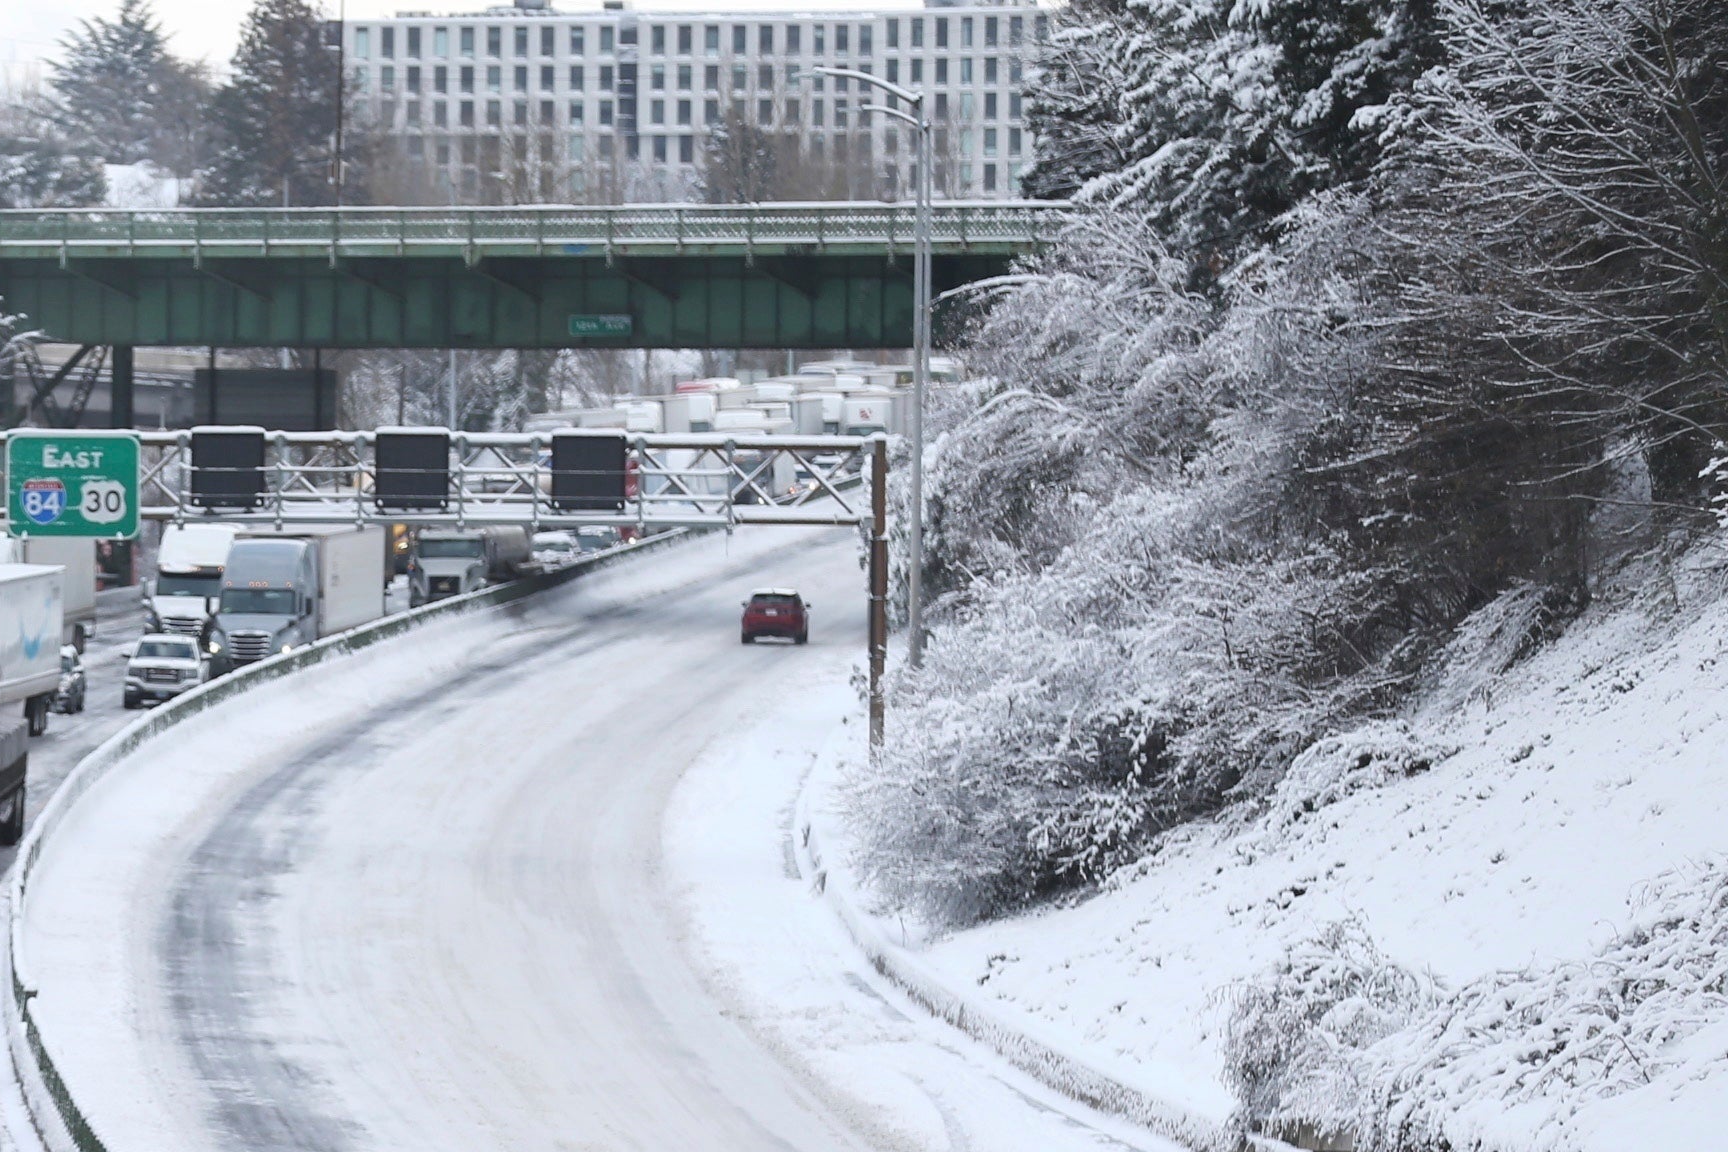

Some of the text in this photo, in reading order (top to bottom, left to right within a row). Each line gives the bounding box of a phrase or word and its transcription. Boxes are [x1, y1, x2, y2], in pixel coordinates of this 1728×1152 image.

[42, 444, 104, 468] EAST
[25, 491, 61, 516] 84
[86, 490, 121, 513] 30
